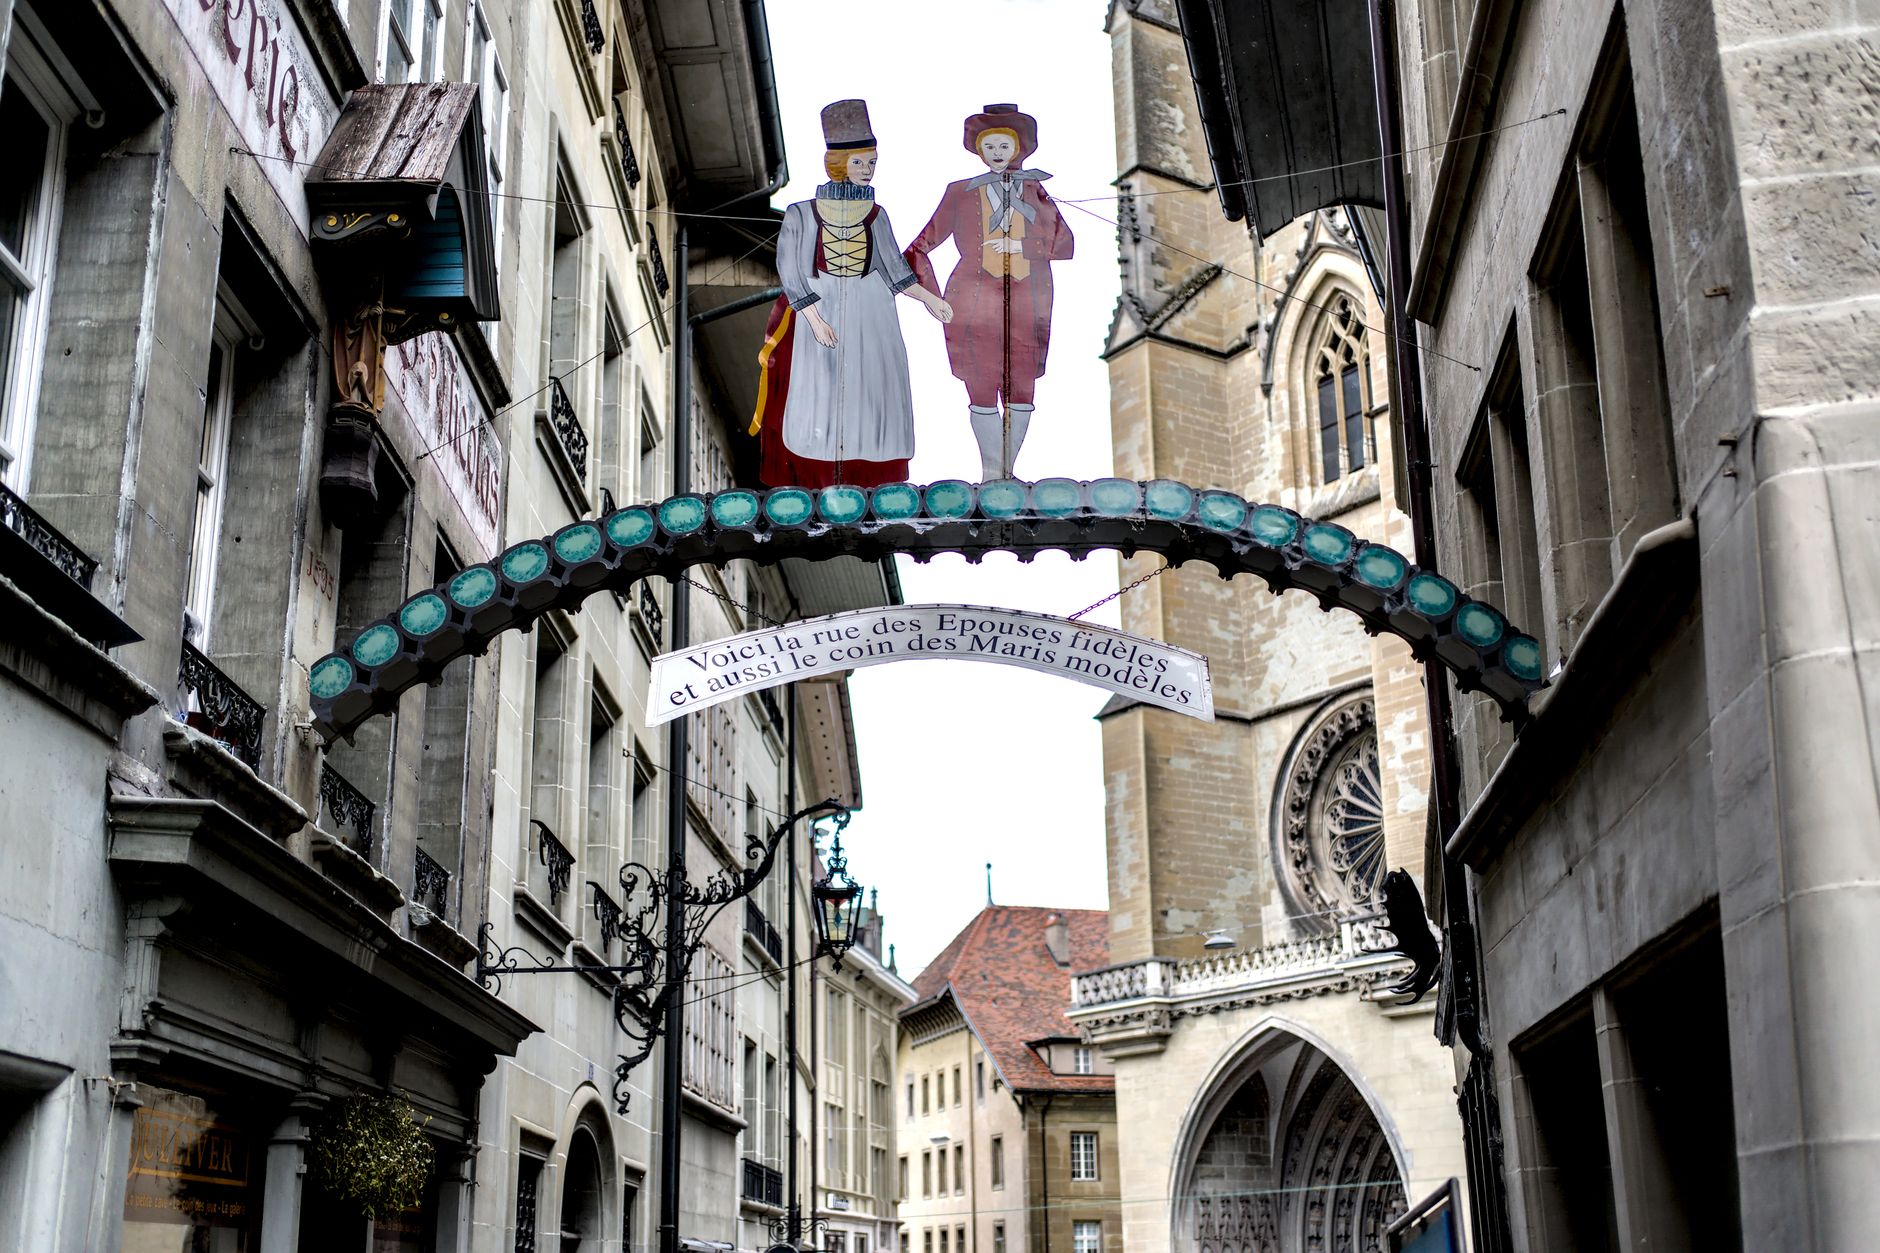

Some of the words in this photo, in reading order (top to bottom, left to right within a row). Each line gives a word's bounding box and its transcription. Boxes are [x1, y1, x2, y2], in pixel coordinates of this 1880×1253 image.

[669, 682, 699, 707] et
[707, 659, 782, 693] aussi
[791, 652, 819, 671] le
[828, 638, 895, 663] coin
[907, 633, 957, 651] des
[969, 633, 1056, 664] Maris
[1063, 655, 1192, 705] modèles
[686, 639, 766, 673] Voici
[774, 634, 804, 654] la
[813, 625, 861, 646] rue
[872, 616, 922, 636] des
[937, 613, 1062, 644] Epouses
[1067, 630, 1169, 674] fidèles
